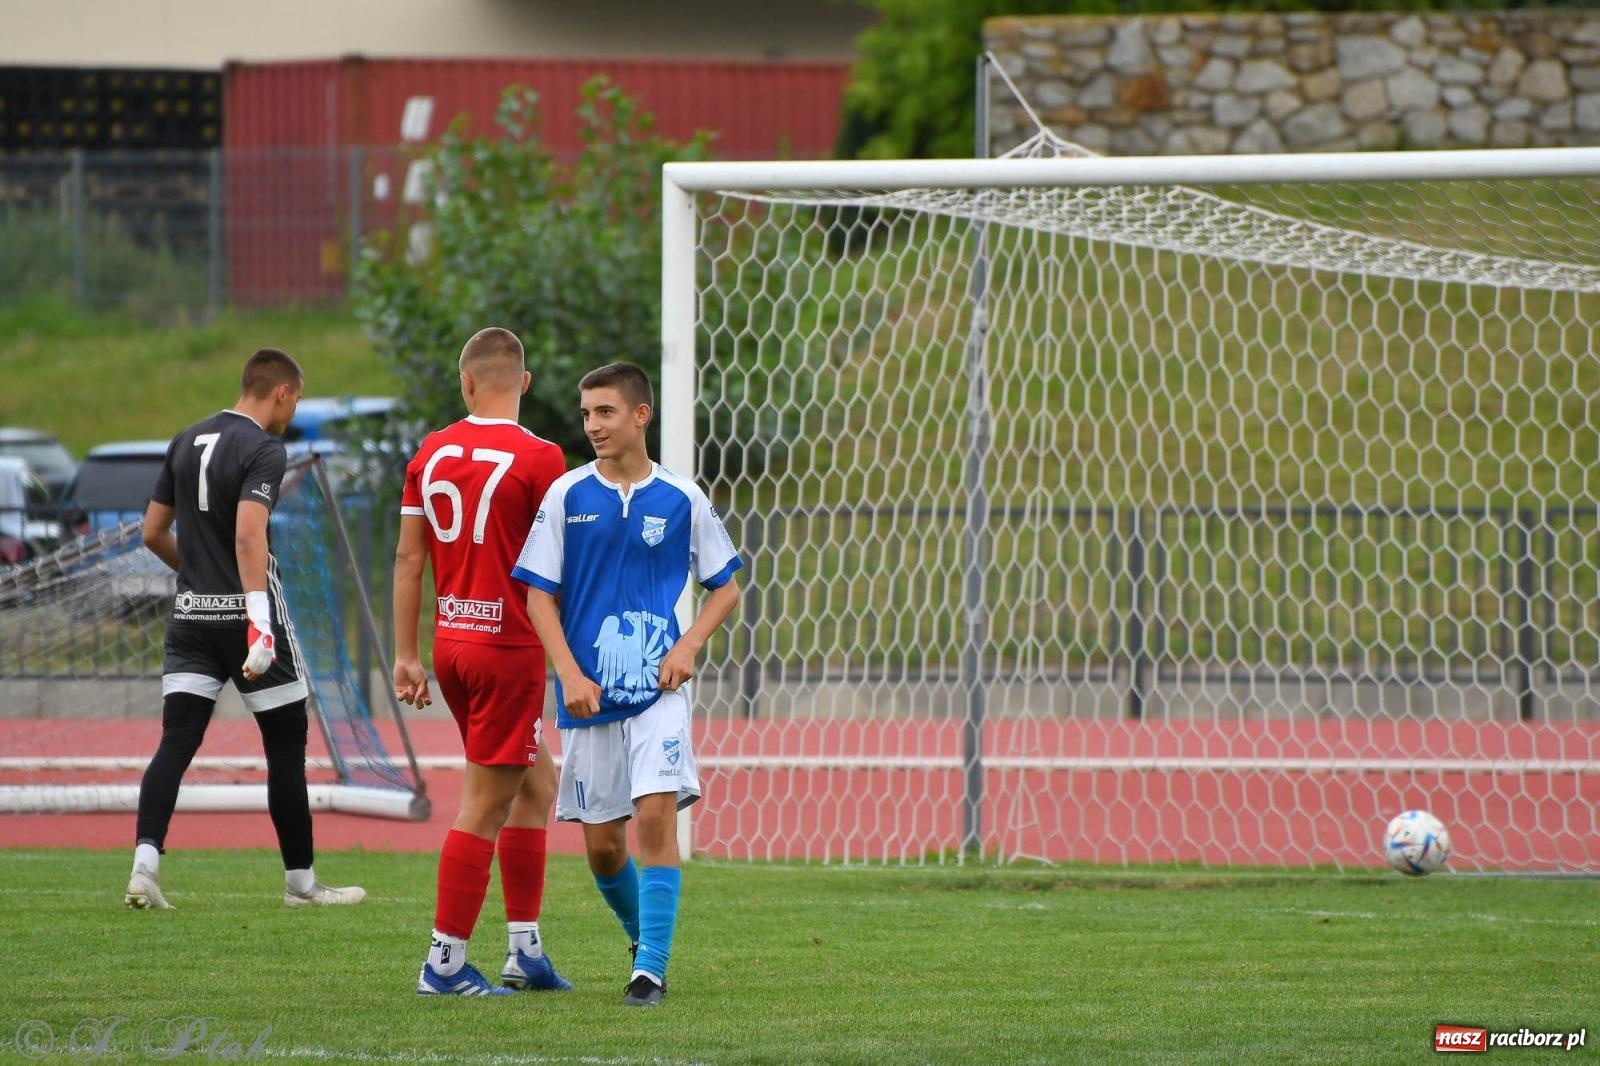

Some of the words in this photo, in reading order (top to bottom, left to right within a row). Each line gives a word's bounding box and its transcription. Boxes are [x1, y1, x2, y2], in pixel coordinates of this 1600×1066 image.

[193, 432, 221, 512] 7
[421, 444, 515, 545] 67
[175, 594, 244, 611] NORMAZET
